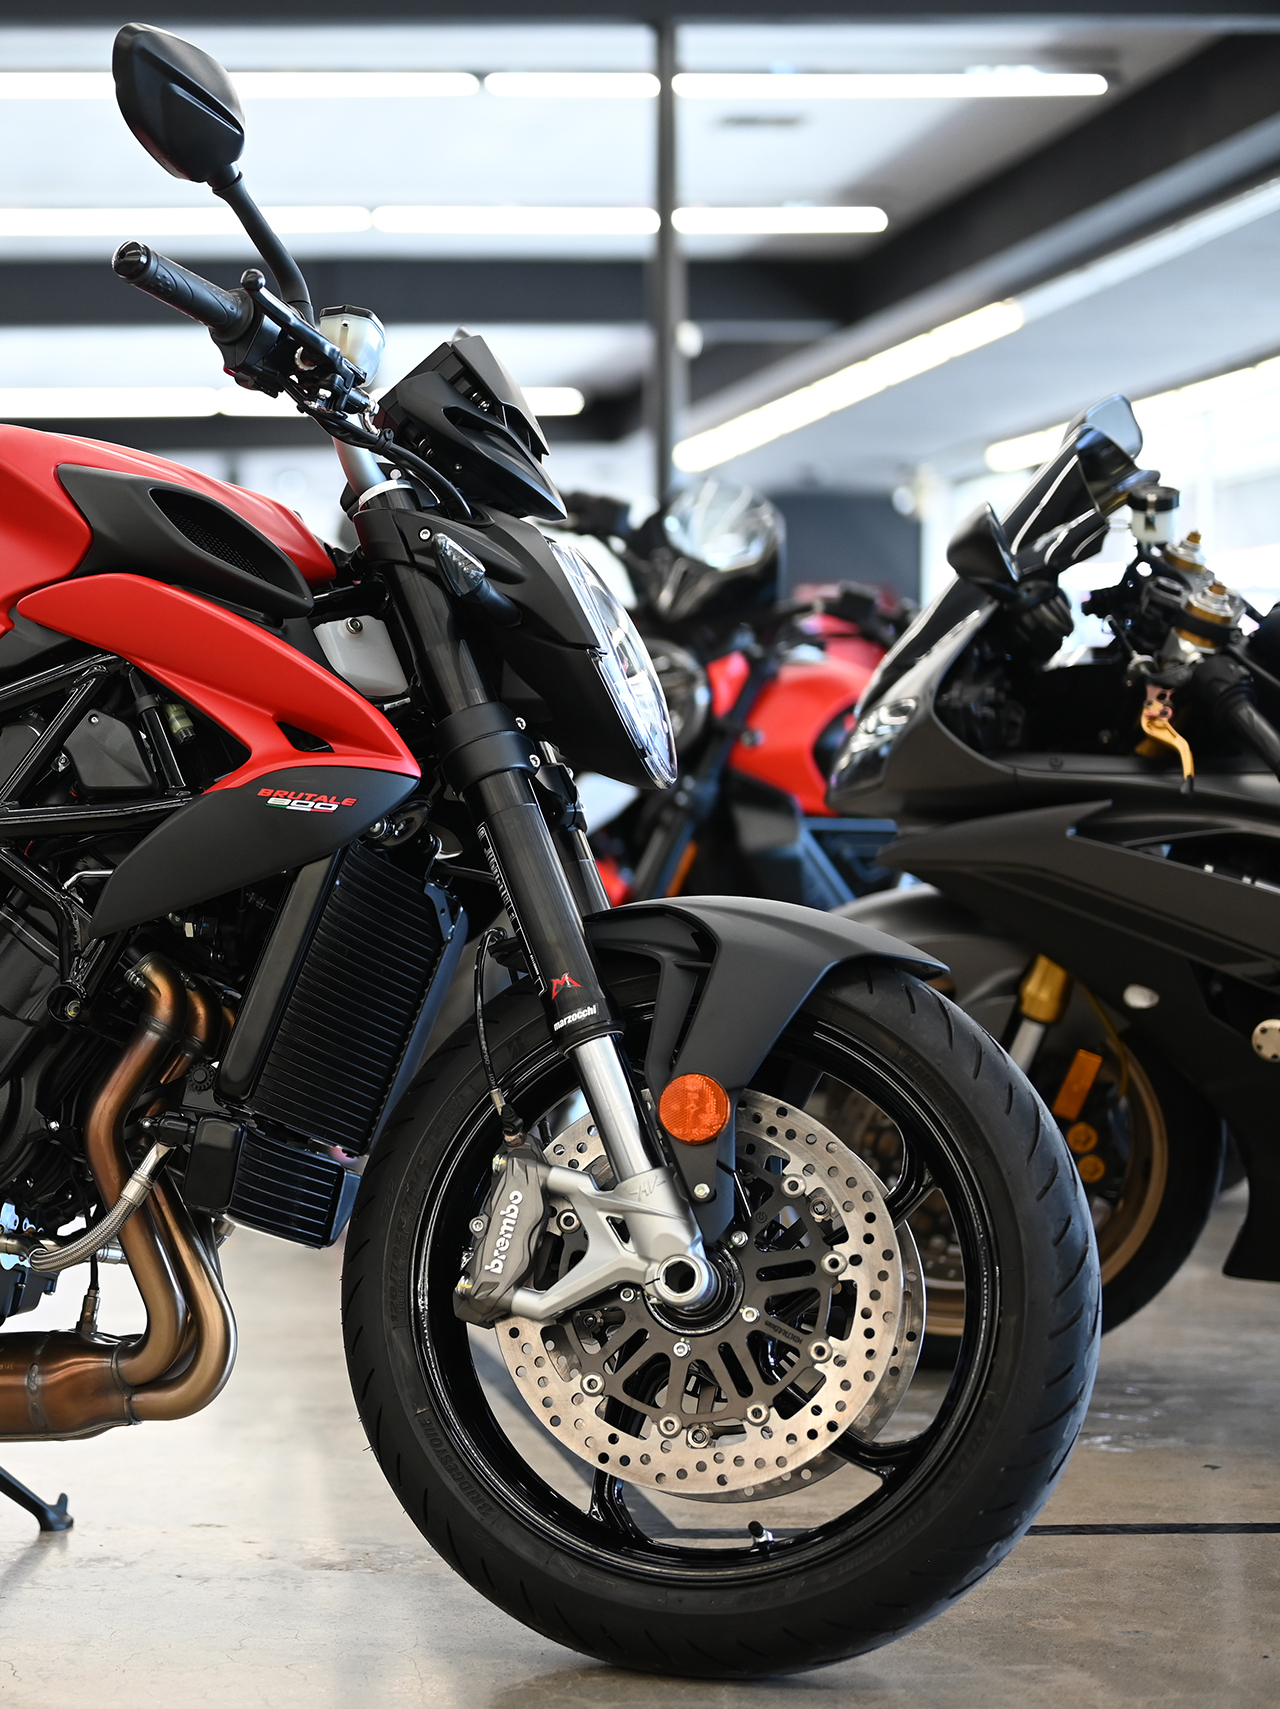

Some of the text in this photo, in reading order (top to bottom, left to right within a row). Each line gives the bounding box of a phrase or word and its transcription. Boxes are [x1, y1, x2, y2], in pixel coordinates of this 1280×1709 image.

[257, 788, 358, 807] BRUTALE
[553, 1004, 598, 1032] marzocchi
[900, 1052, 985, 1152] BRIDGESTONE
[484, 1190, 524, 1275] brembo
[396, 1270, 407, 1312] TUBELESS
[416, 1414, 496, 1519] BRIDGESTONE
